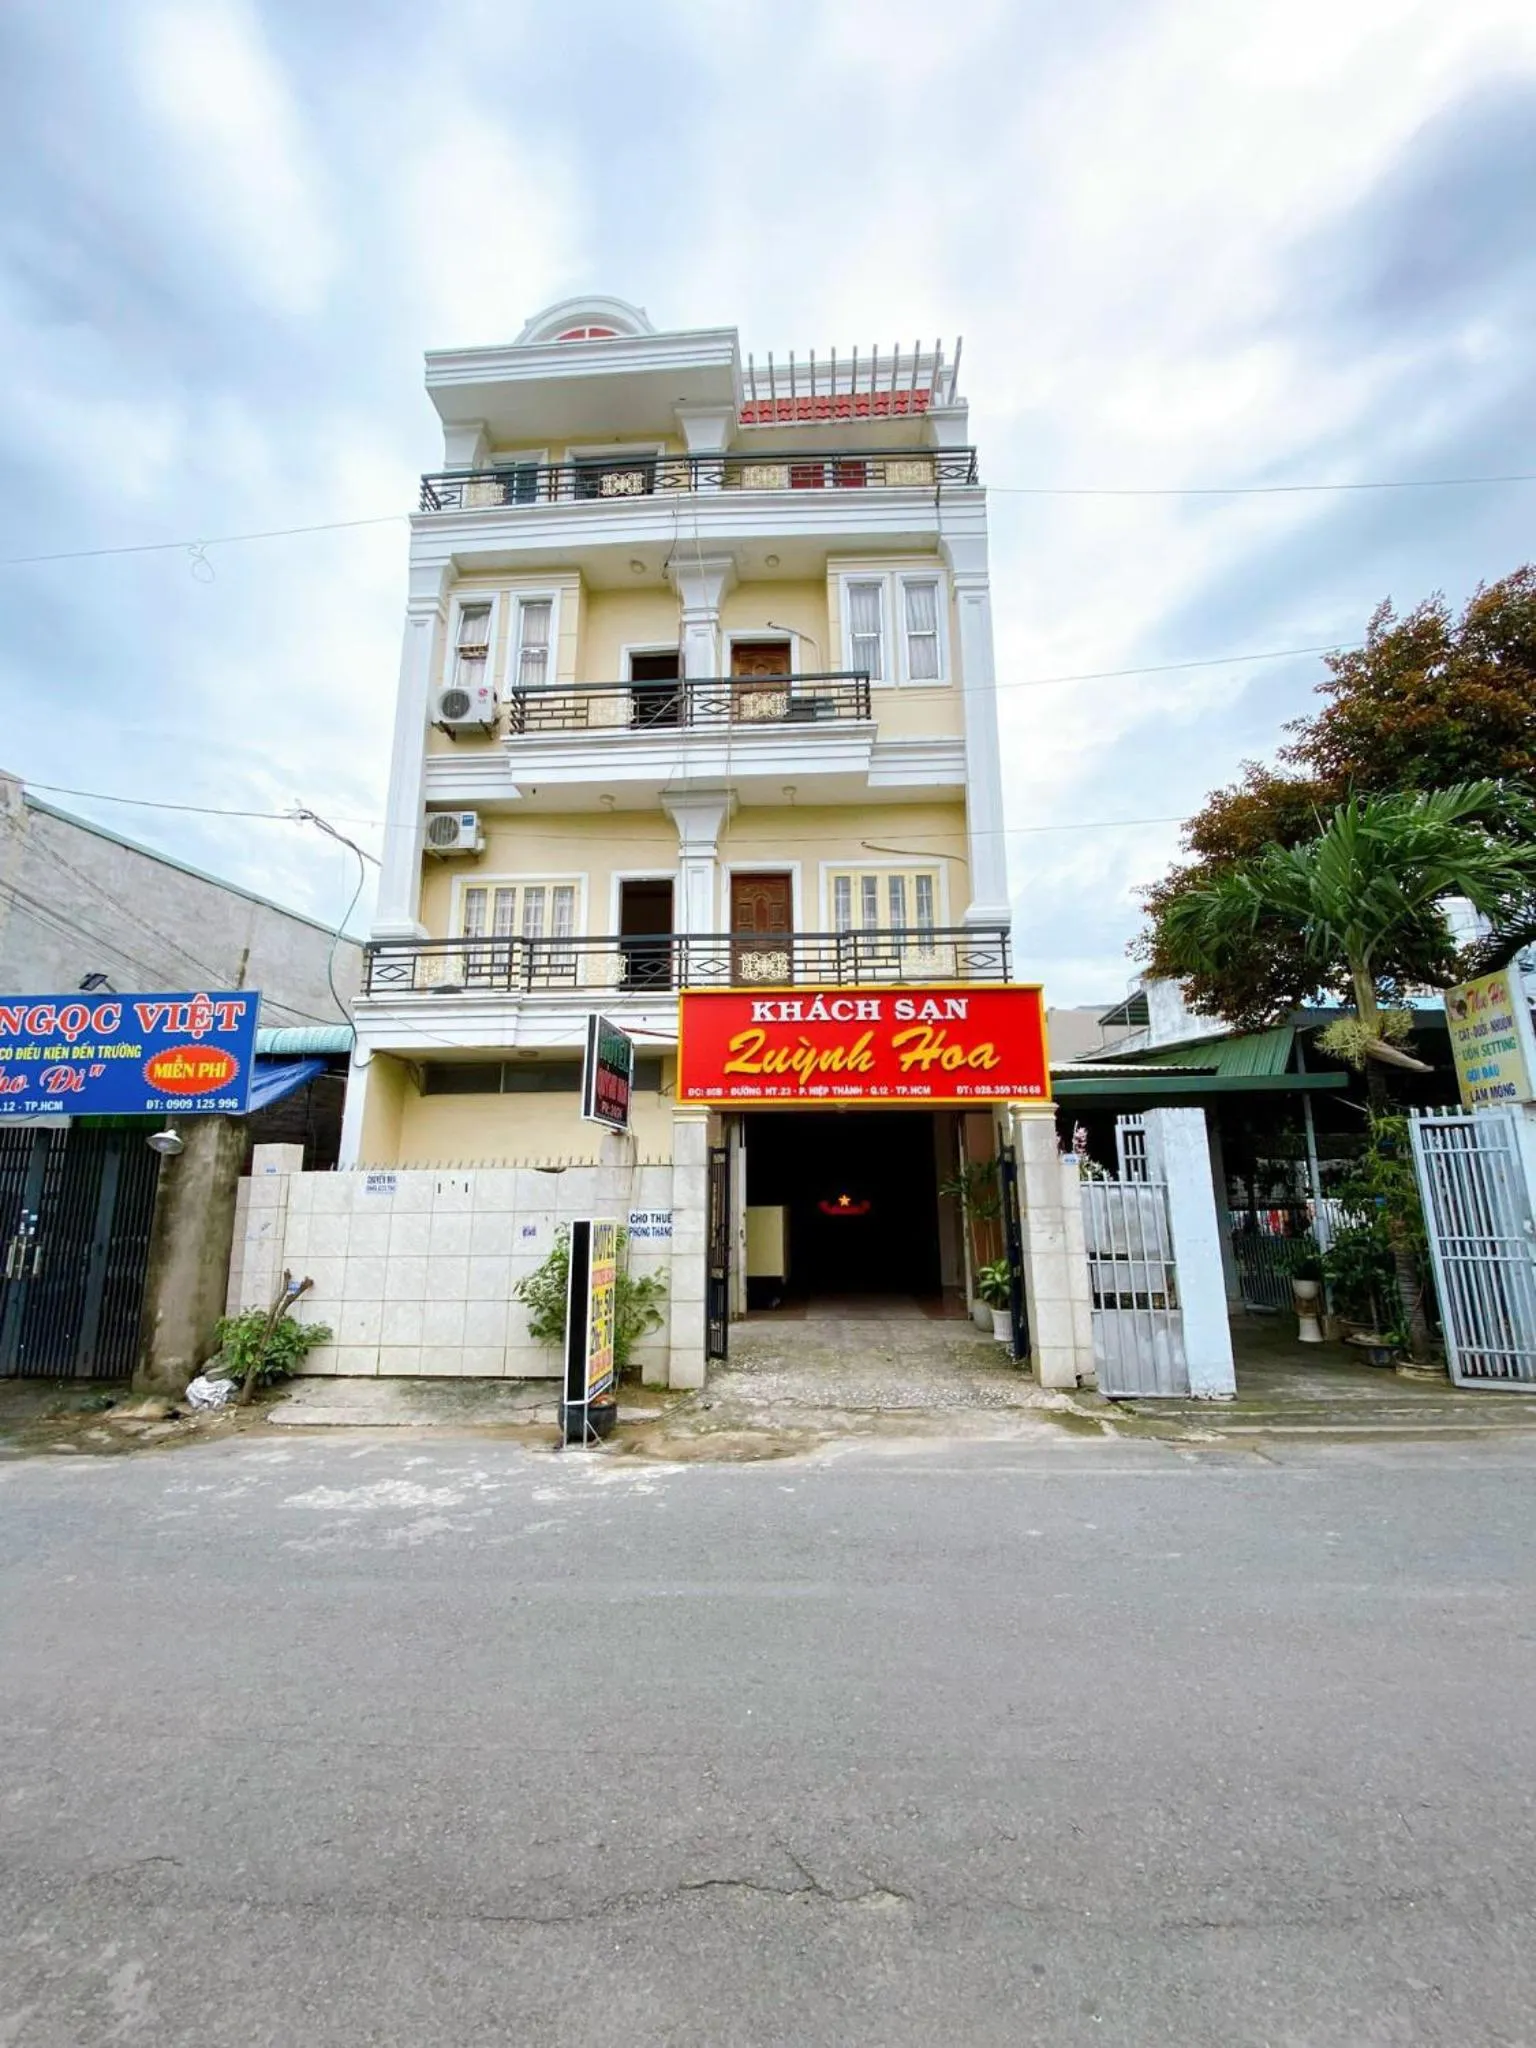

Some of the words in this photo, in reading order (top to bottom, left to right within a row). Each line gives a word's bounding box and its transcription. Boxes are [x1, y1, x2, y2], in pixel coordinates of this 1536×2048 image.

[0, 1003, 122, 1042] NGỌC
[133, 993, 246, 1039] VIỆT
[752, 994, 881, 1022] KHÁCH
[895, 999, 968, 1025] SẠN
[724, 1028, 875, 1085] Quỳnh
[892, 1026, 1000, 1072] Hoa
[198, 1056, 228, 1078] PHÍ
[896, 1085, 931, 1095] TP.HCM
[25, 1100, 63, 1111] TP.HCM
[166, 1099, 192, 1109] 0909
[197, 1099, 216, 1109] 125
[218, 1098, 239, 1109] 996
[630, 1213, 648, 1224] CHO
